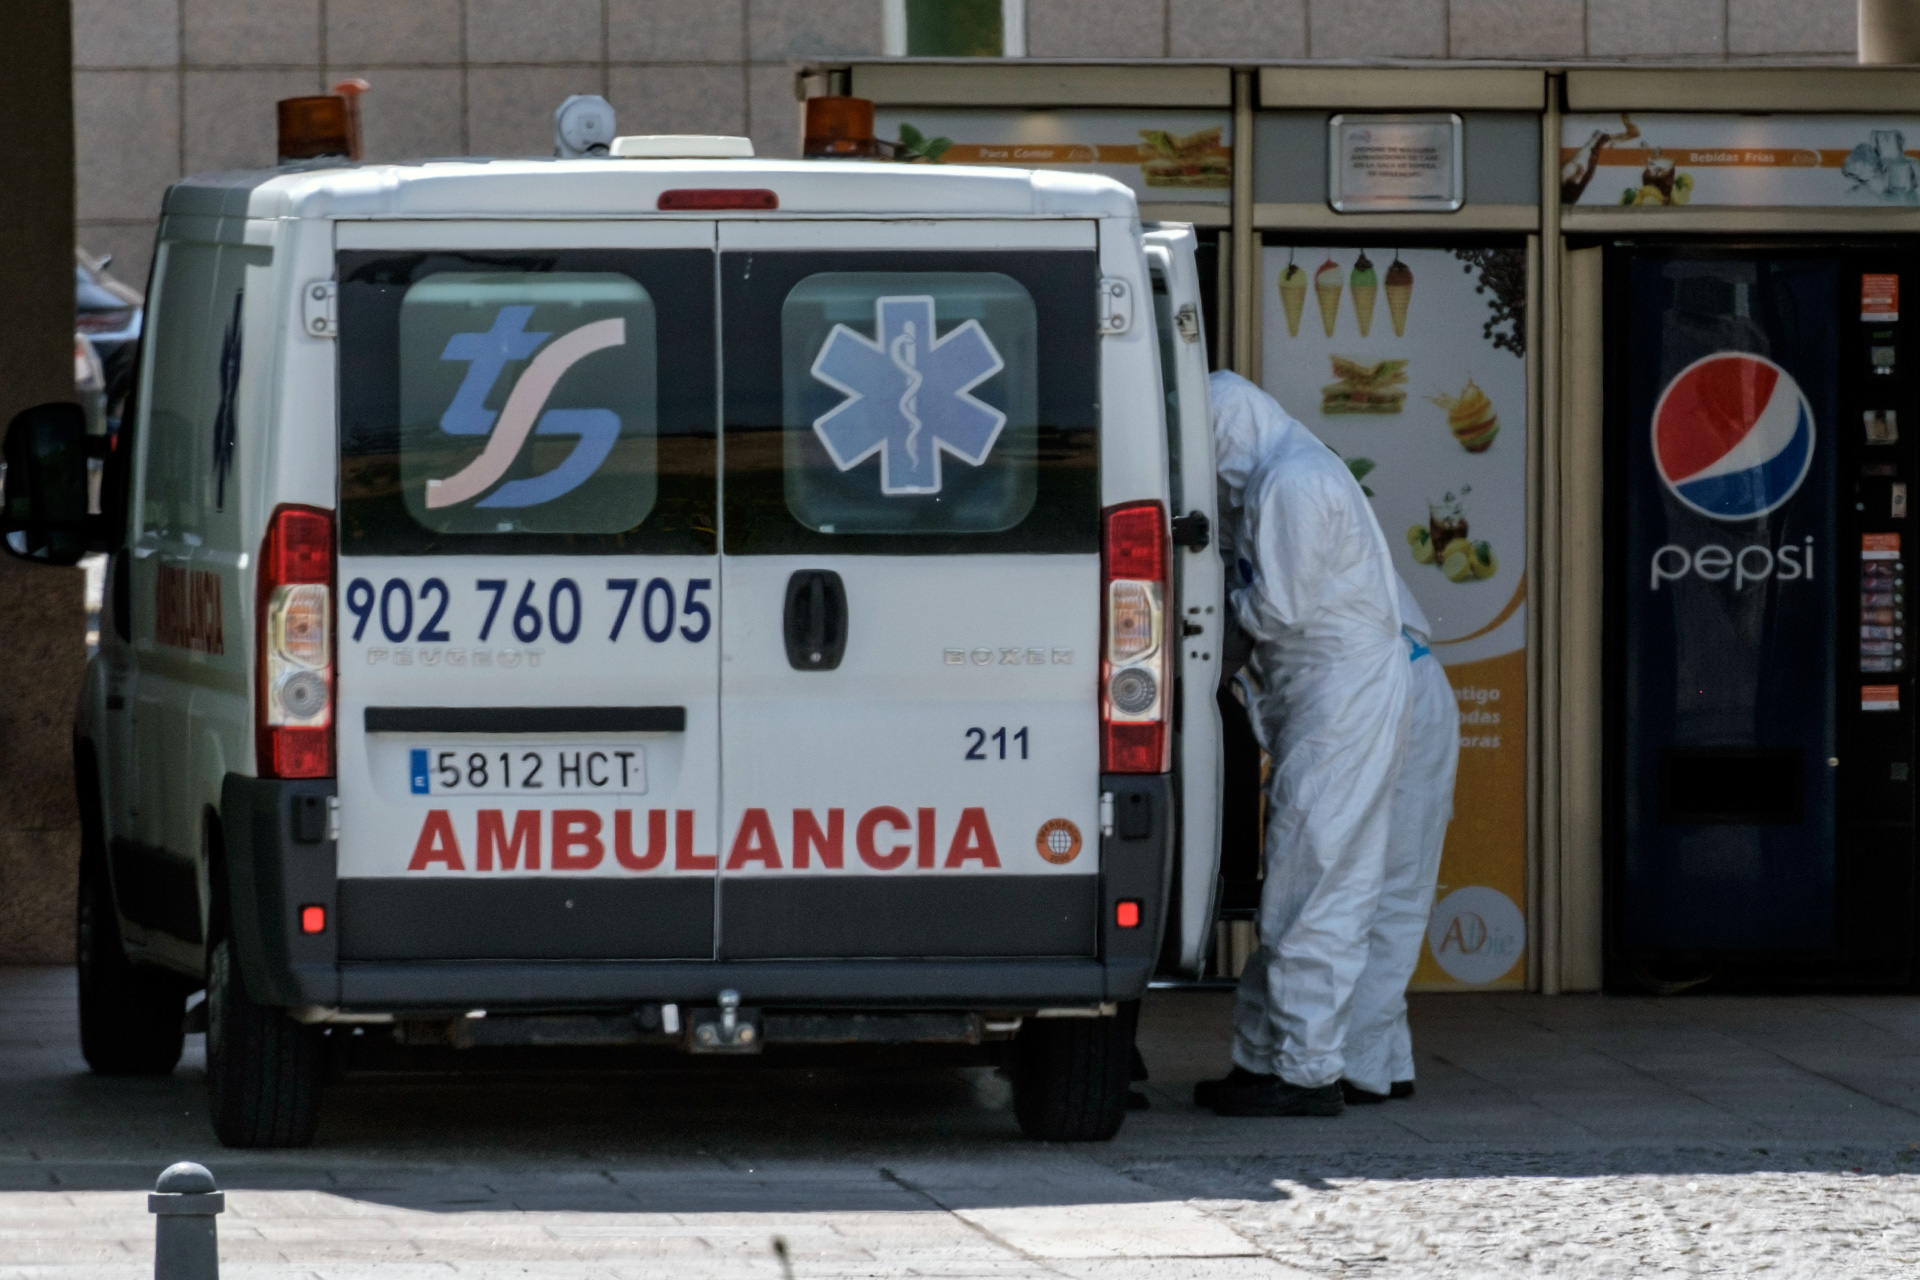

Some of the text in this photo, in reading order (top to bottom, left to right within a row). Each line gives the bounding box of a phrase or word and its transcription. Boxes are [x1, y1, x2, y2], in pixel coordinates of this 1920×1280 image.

[1690, 152, 1739, 163] Bebidas
[1651, 536, 1814, 590] pepsi
[346, 577, 712, 644] 902 760 705
[366, 647, 546, 669] PEUGEOT
[943, 646, 1075, 667] BOXER
[965, 726, 1029, 761] 211
[439, 752, 543, 788] 5812
[559, 751, 635, 788] HCT
[407, 805, 1002, 873] AMBULANCIA
